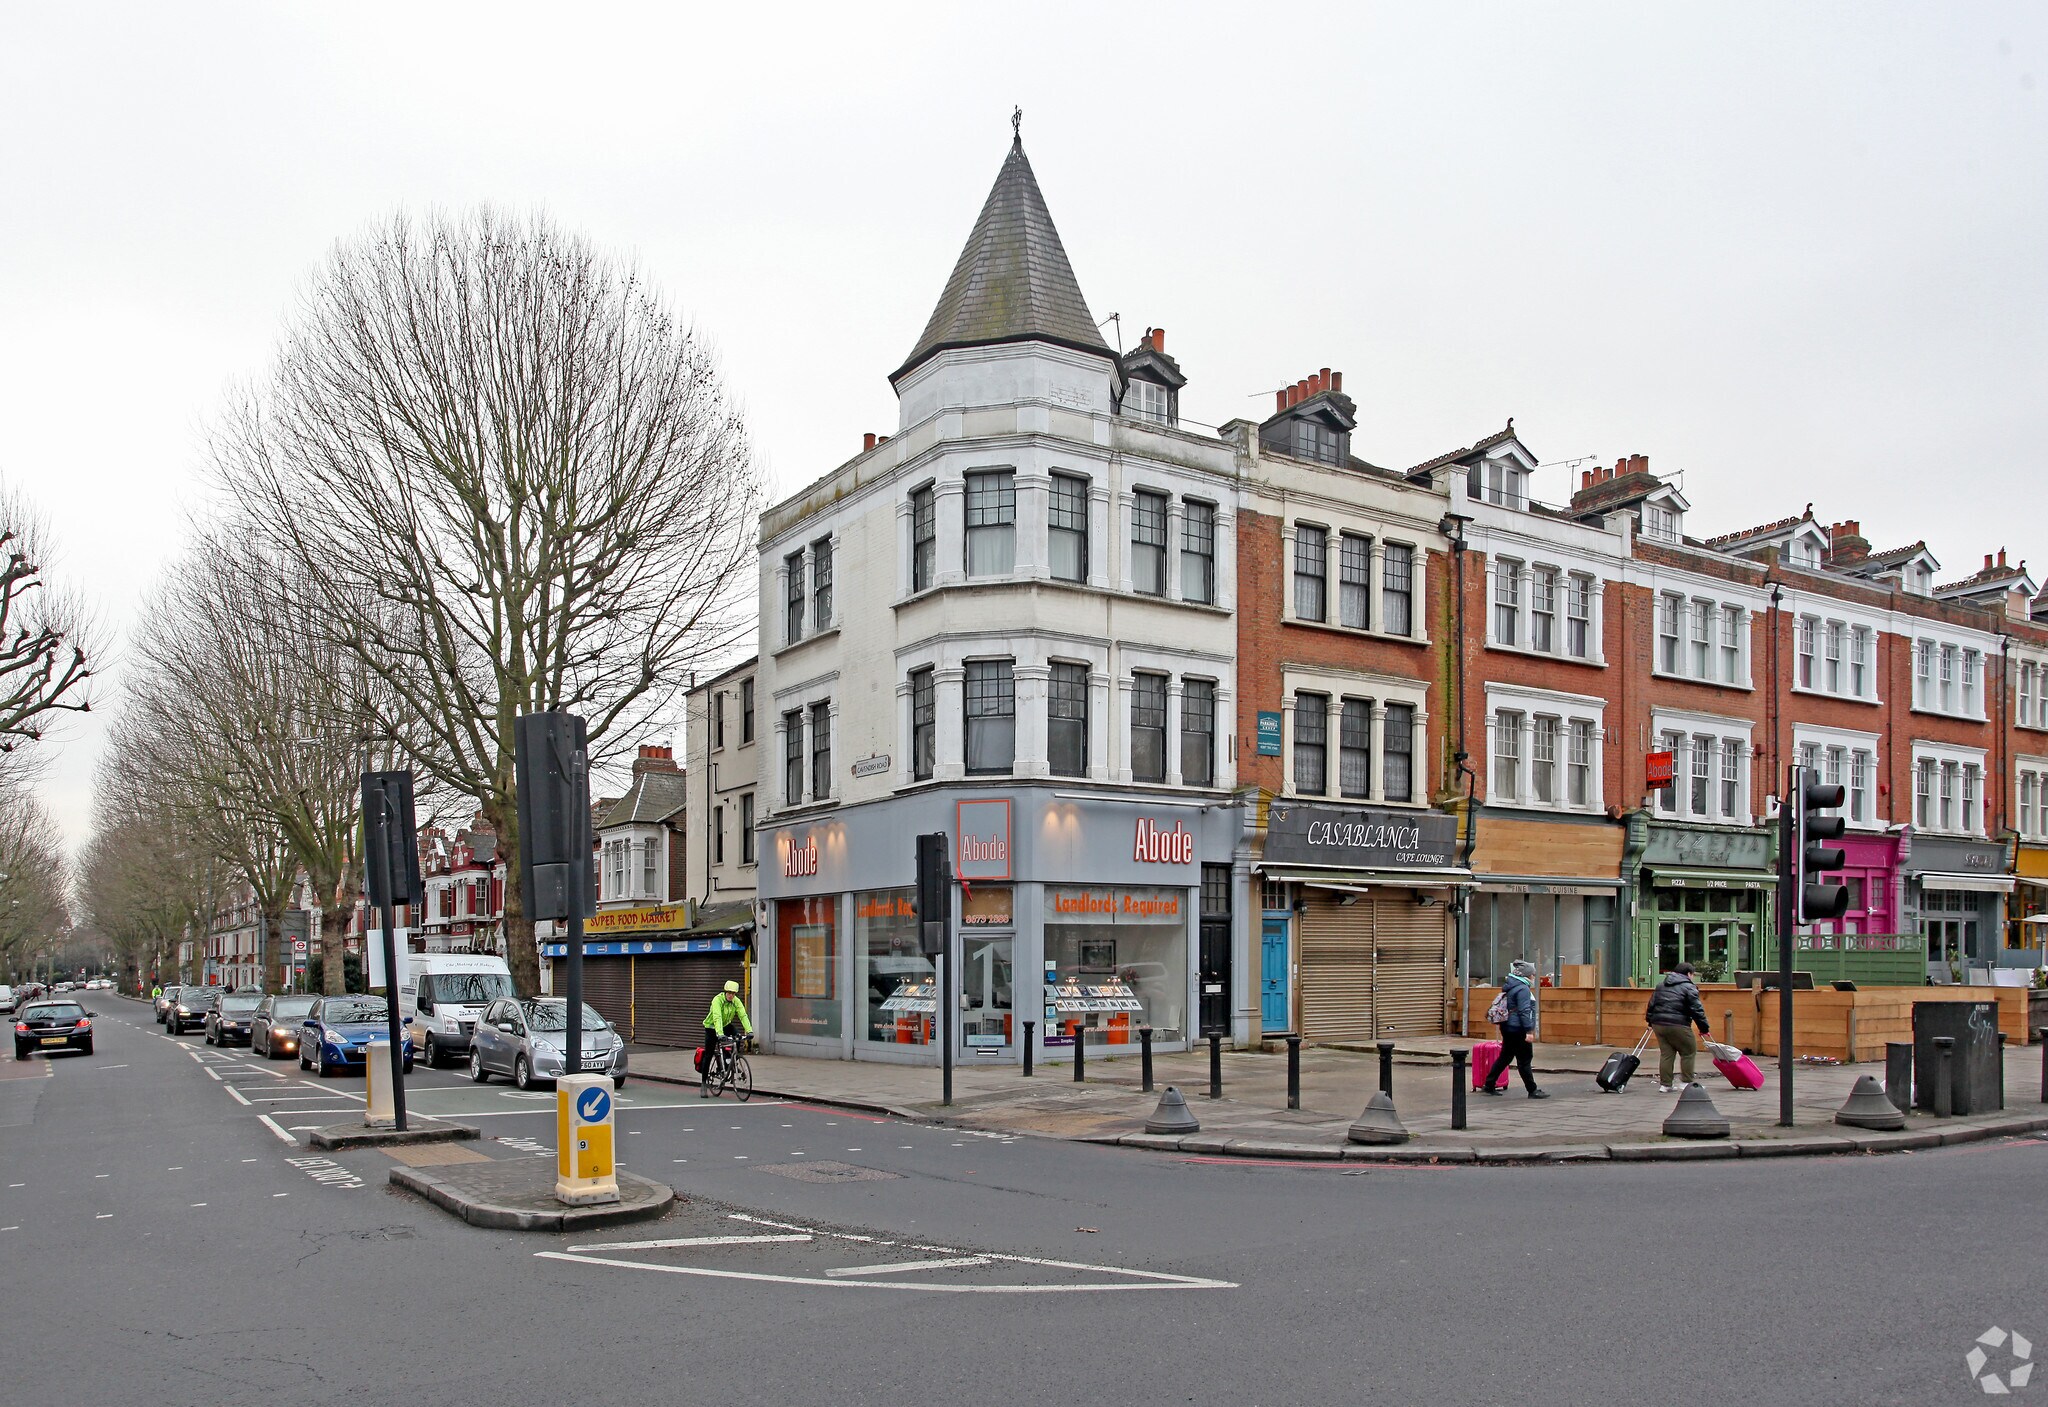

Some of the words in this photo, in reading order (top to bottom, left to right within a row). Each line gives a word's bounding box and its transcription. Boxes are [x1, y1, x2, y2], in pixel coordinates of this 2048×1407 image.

[857, 763, 877, 773] CAVENDISH
[877, 761, 887, 770] ROAD
[1647, 760, 1672, 779] Abode
[1134, 817, 1193, 865] Abode
[1307, 821, 1420, 850] CASABLANCA
[784, 836, 818, 878] Abode
[962, 834, 1006, 861] Abode
[1396, 852, 1415, 864] CAFE
[1415, 852, 1445, 866] LOUNGE
[1512, 885, 1527, 893] FINE
[1552, 886, 1578, 894] CUISINE
[1671, 879, 1686, 887] PIZZA
[1706, 880, 1714, 888] 1/2
[1714, 880, 1727, 888] PRICE
[1745, 881, 1761, 889] PASTA
[856, 898, 894, 919] Landlords
[1055, 891, 1118, 913] Landlords
[1123, 894, 1179, 918] Required
[590, 914, 615, 927] SUPER
[617, 913, 638, 925] FOOD
[640, 910, 677, 924] MARKET
[579, 1140, 586, 1150] 9
